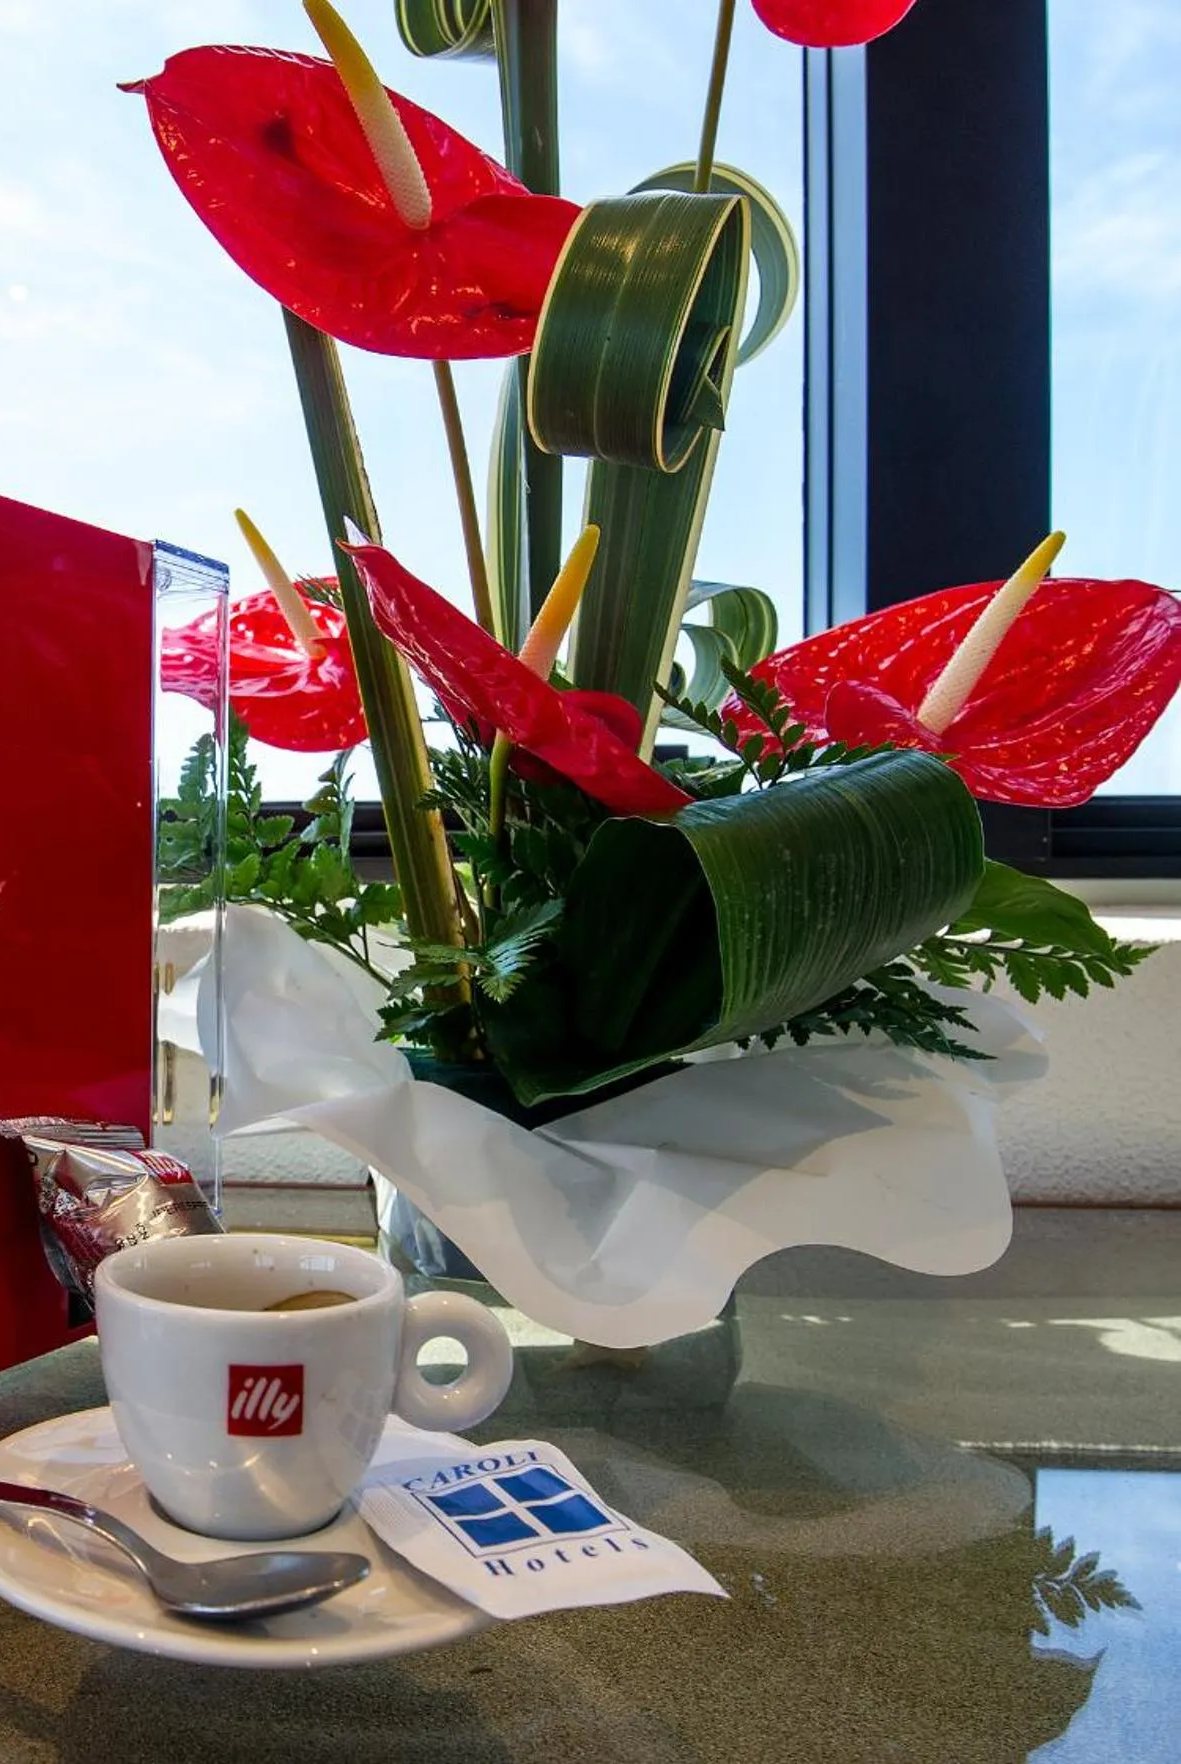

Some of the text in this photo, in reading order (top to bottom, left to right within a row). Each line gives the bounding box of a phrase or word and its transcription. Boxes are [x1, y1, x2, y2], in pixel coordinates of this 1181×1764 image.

[231, 1377, 300, 1431] illy
[403, 1451, 539, 1491] CAROLI
[483, 1537, 650, 1576] Hotels
